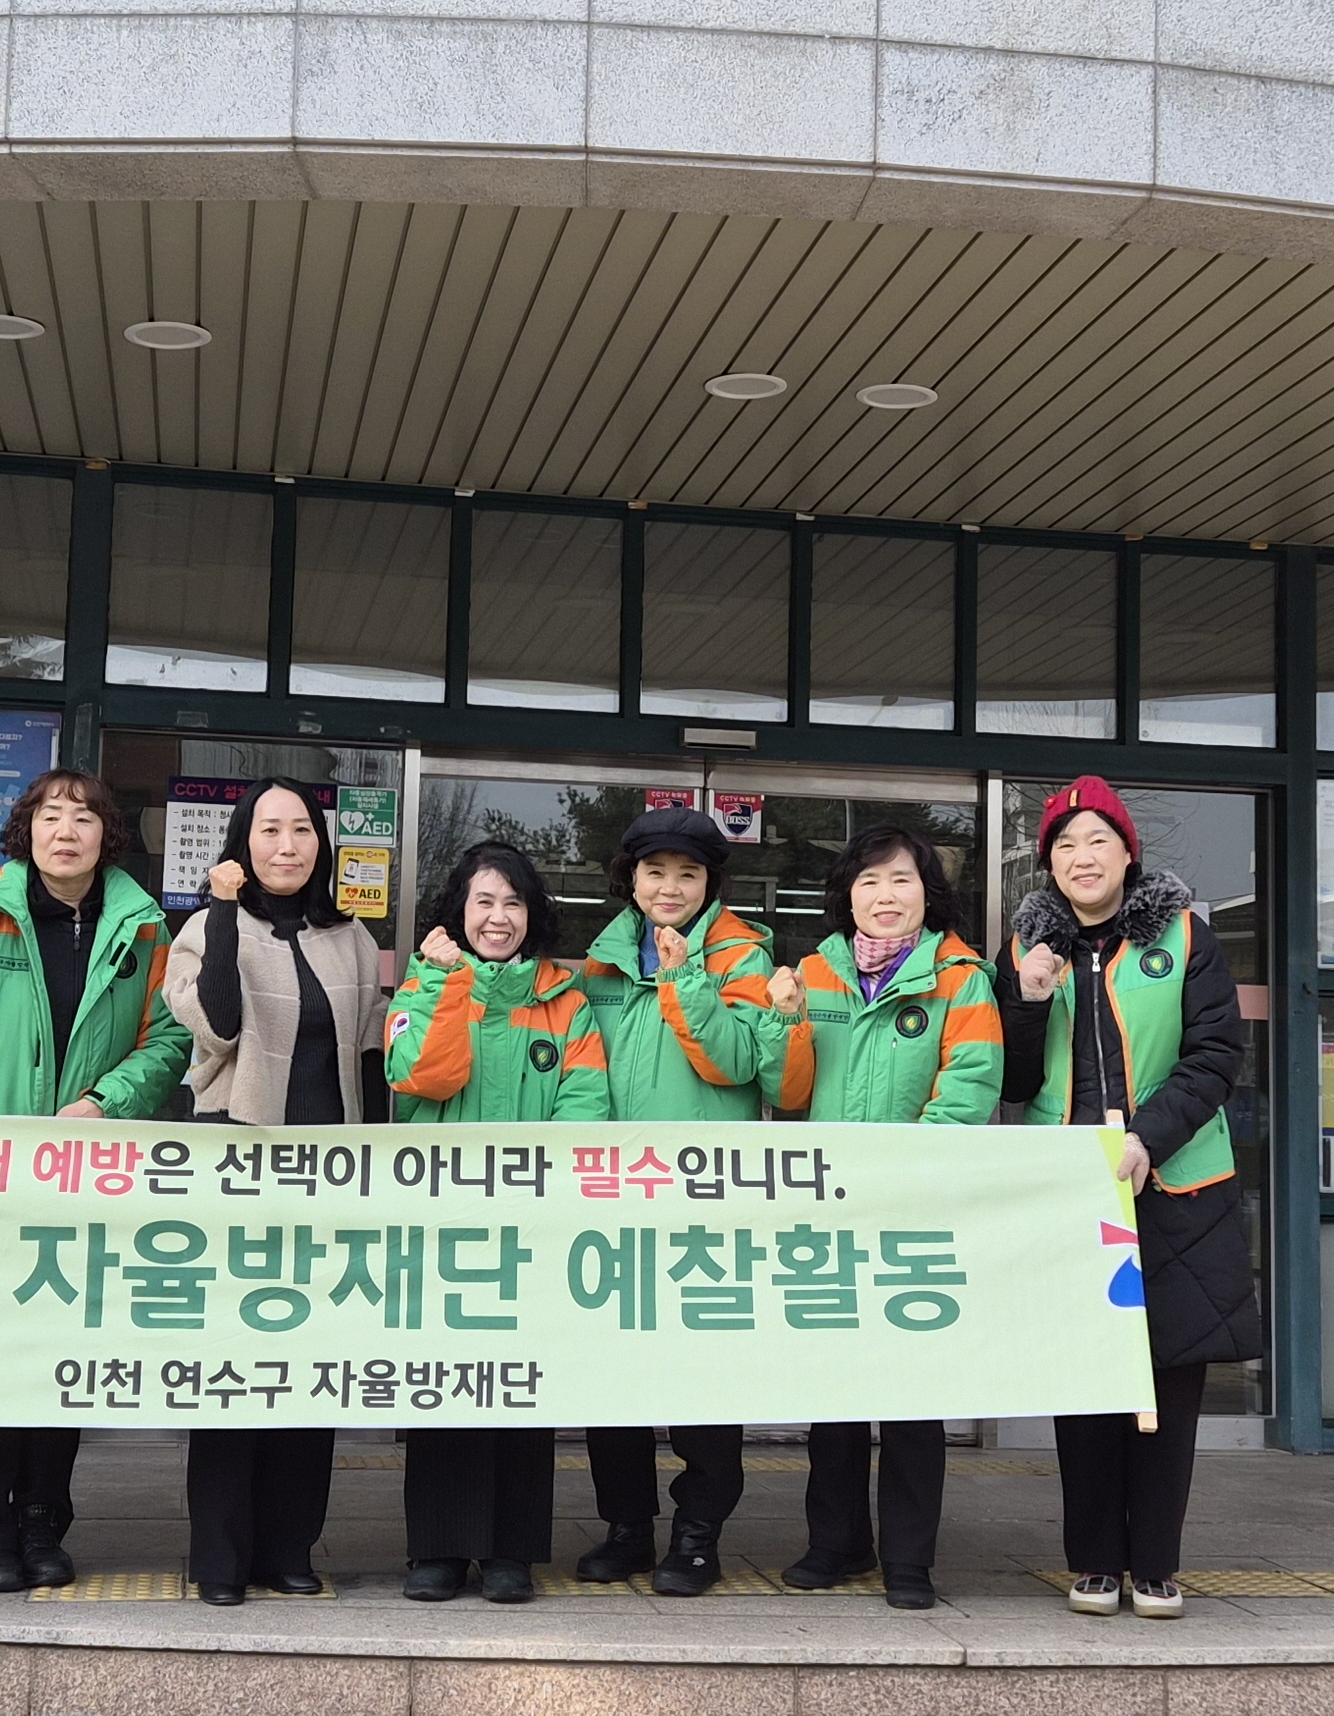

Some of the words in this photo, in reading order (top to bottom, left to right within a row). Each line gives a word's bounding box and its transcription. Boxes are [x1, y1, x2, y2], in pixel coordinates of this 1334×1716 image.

[174, 783, 217, 797] CCTV
[361, 821, 393, 835] AED
[358, 888, 381, 900] AED
[31, 1138, 195, 1196] 예방은
[214, 1141, 372, 1198] 선택이
[392, 1145, 553, 1199] 아니라
[571, 1145, 847, 1201] 필수입니다.
[13, 1220, 533, 1333] 자율방재단
[566, 1223, 968, 1332] 예찰활동
[54, 1357, 143, 1410] 인천
[159, 1357, 293, 1410] 연수구
[309, 1357, 544, 1410] 자율방재단
